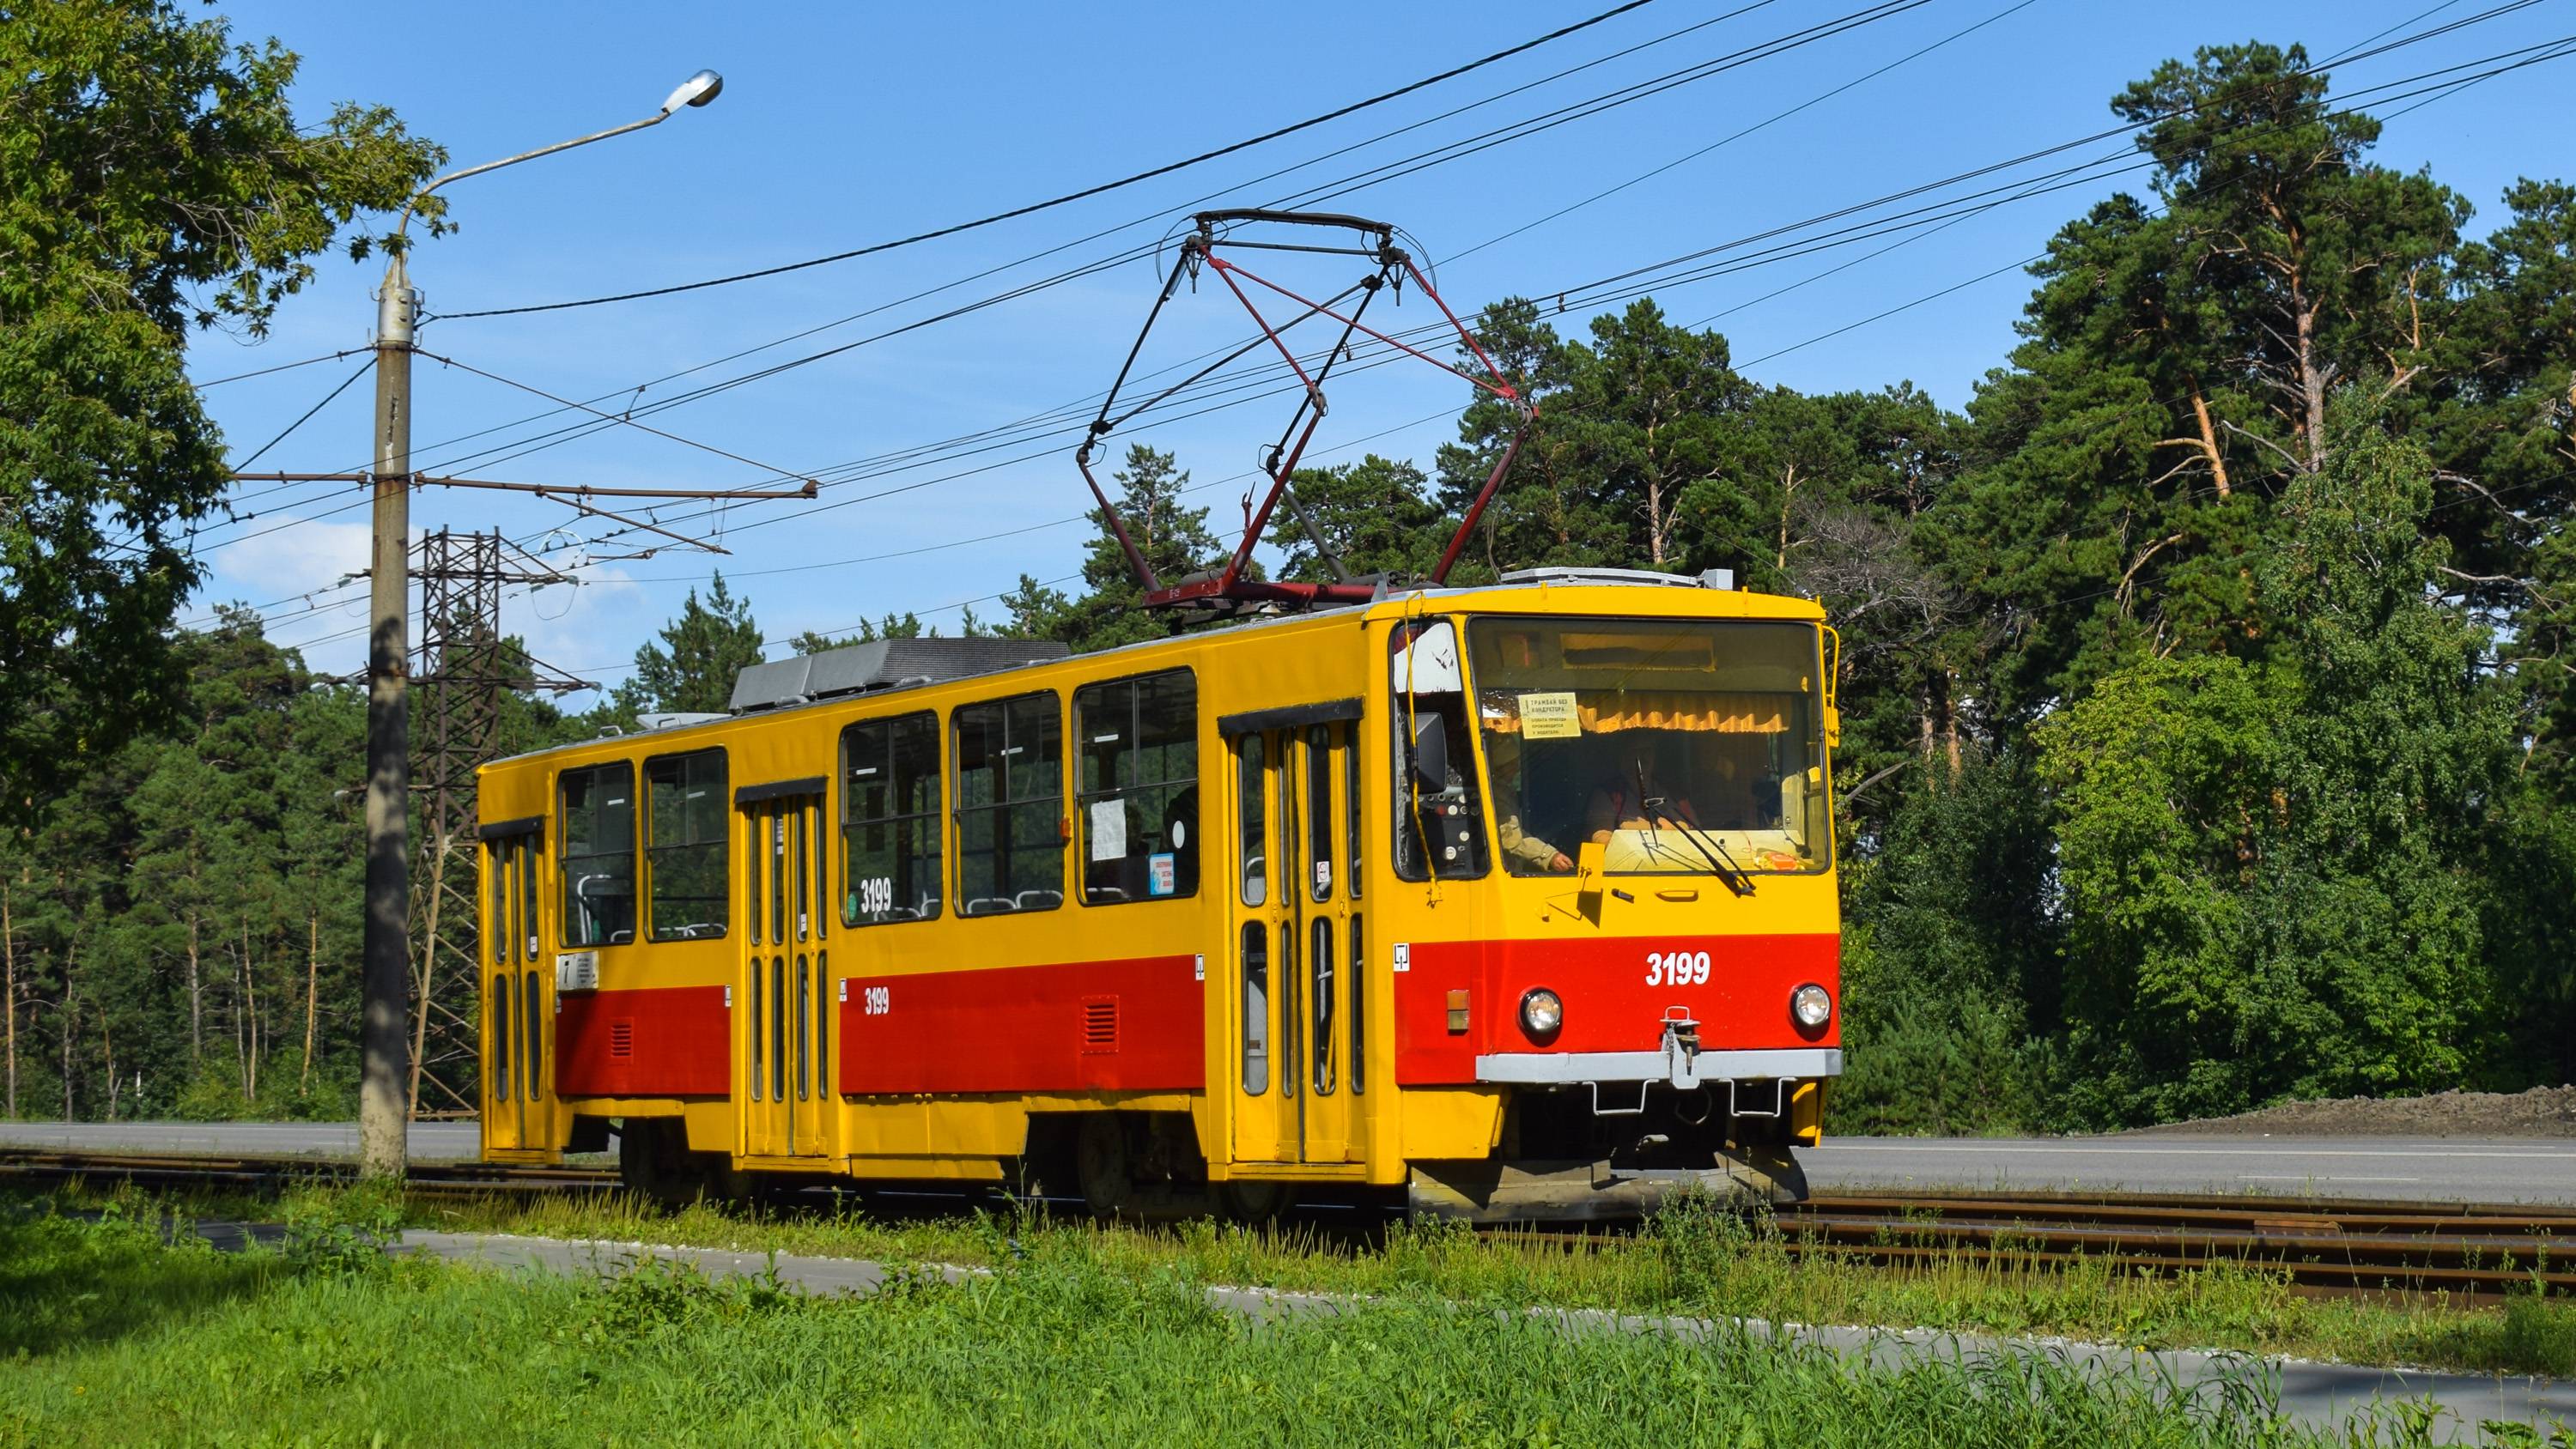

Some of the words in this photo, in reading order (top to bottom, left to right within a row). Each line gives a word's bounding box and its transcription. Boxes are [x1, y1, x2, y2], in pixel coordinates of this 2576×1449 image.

[861, 876, 891, 913] 3199
[1645, 951, 1710, 986] 3199
[865, 986, 890, 1016] 3199
